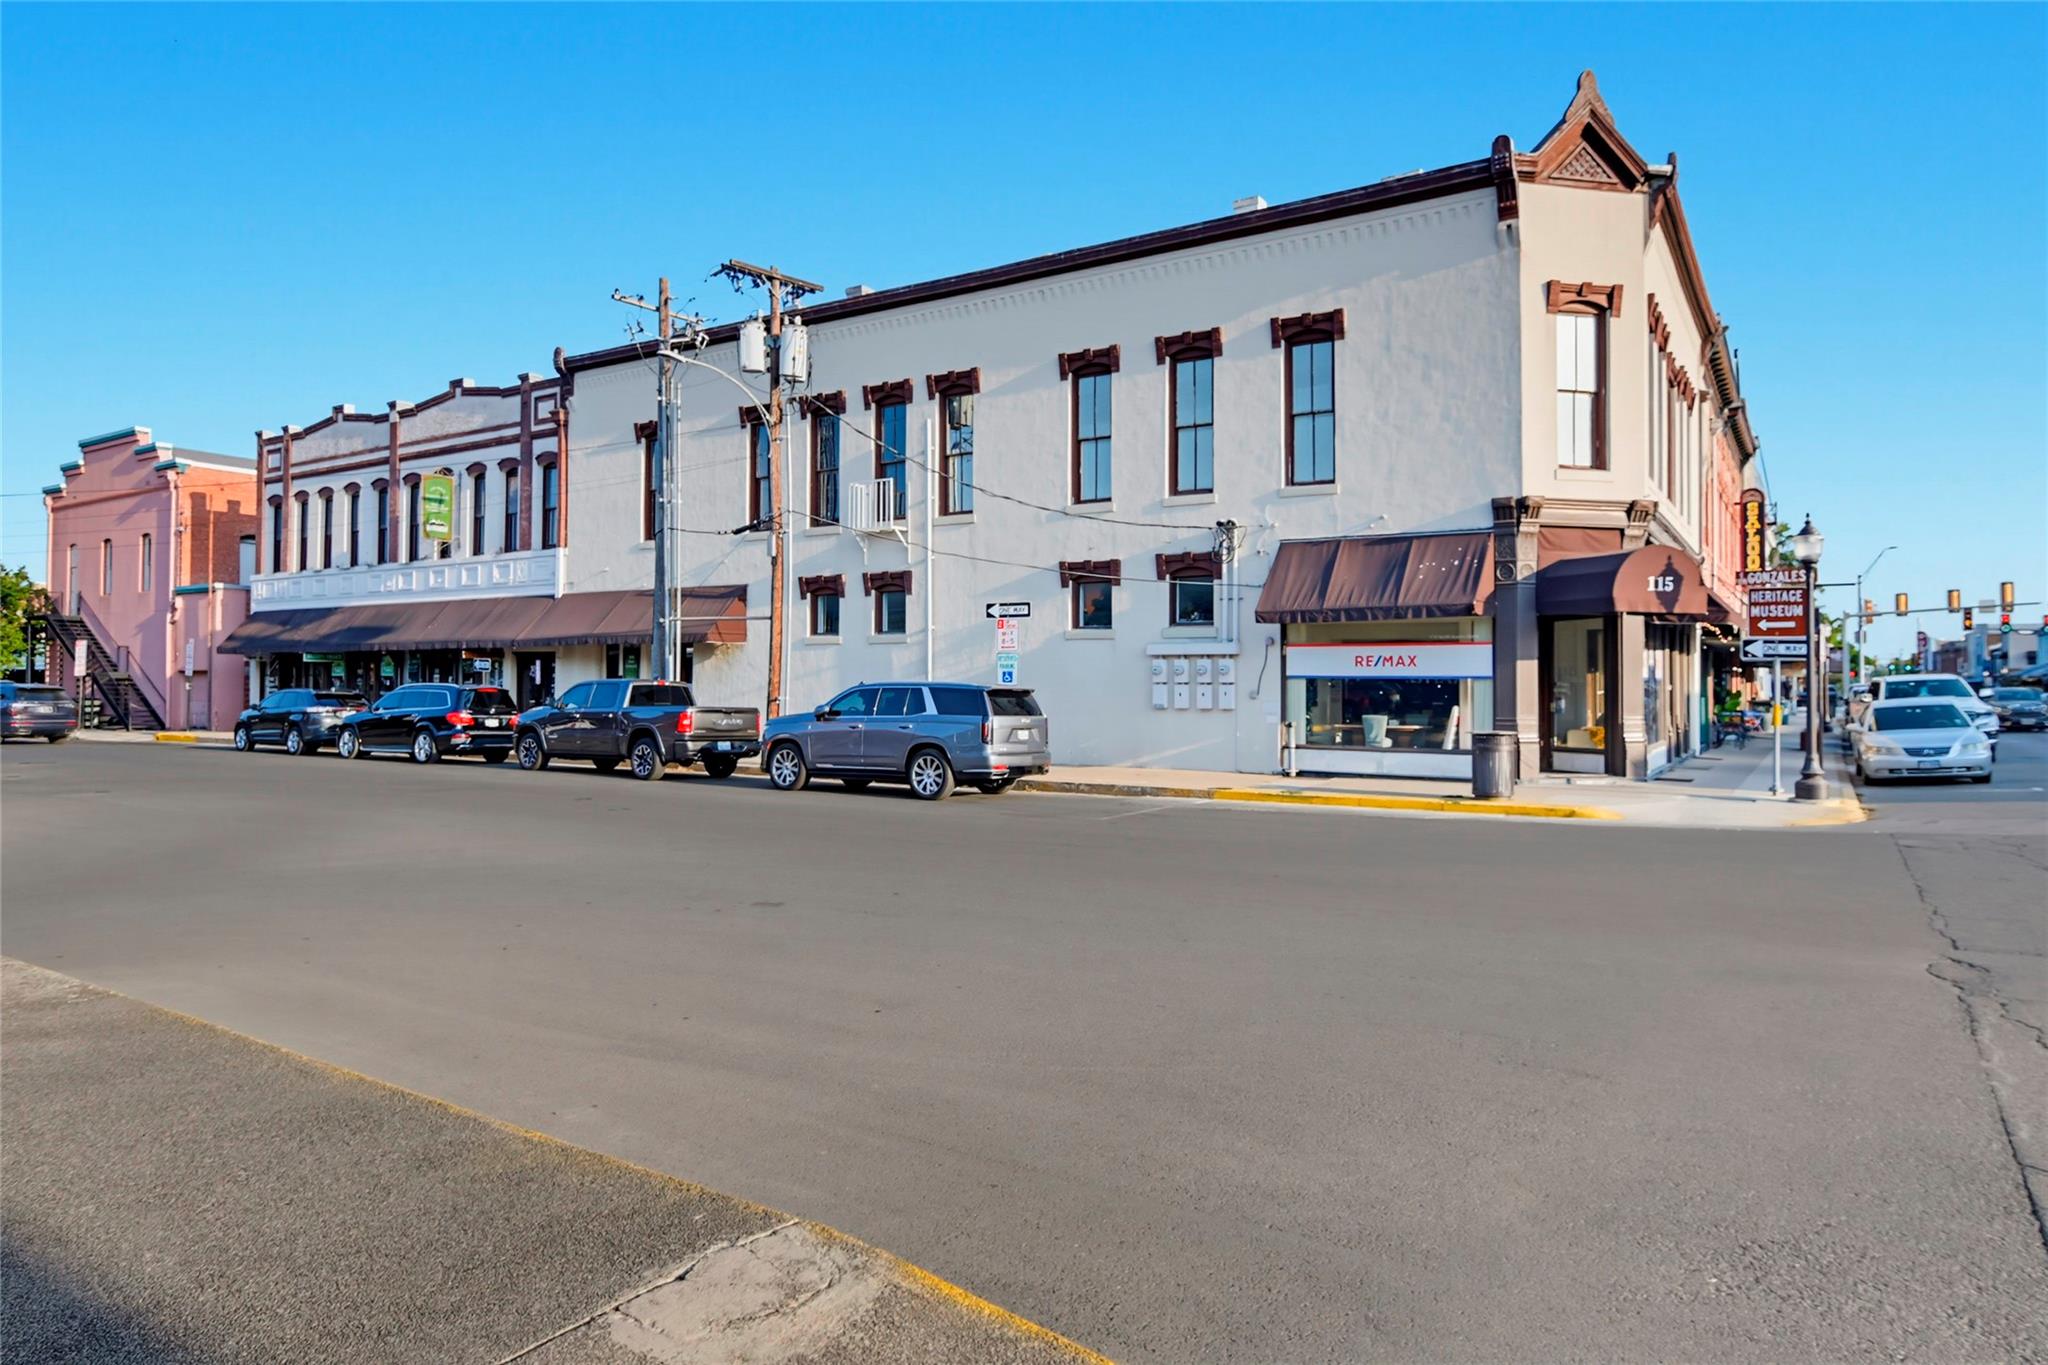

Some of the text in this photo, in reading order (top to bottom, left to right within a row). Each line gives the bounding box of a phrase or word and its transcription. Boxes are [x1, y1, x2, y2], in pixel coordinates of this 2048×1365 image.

[1745, 501, 1763, 572] SALOO
[1747, 569, 1807, 584] GONZALES
[1647, 576, 1674, 592] 115
[1750, 590, 1803, 603] HERITAGE
[1750, 605, 1804, 617] MUSEUM
[1355, 655, 1417, 667] RE/MAX
